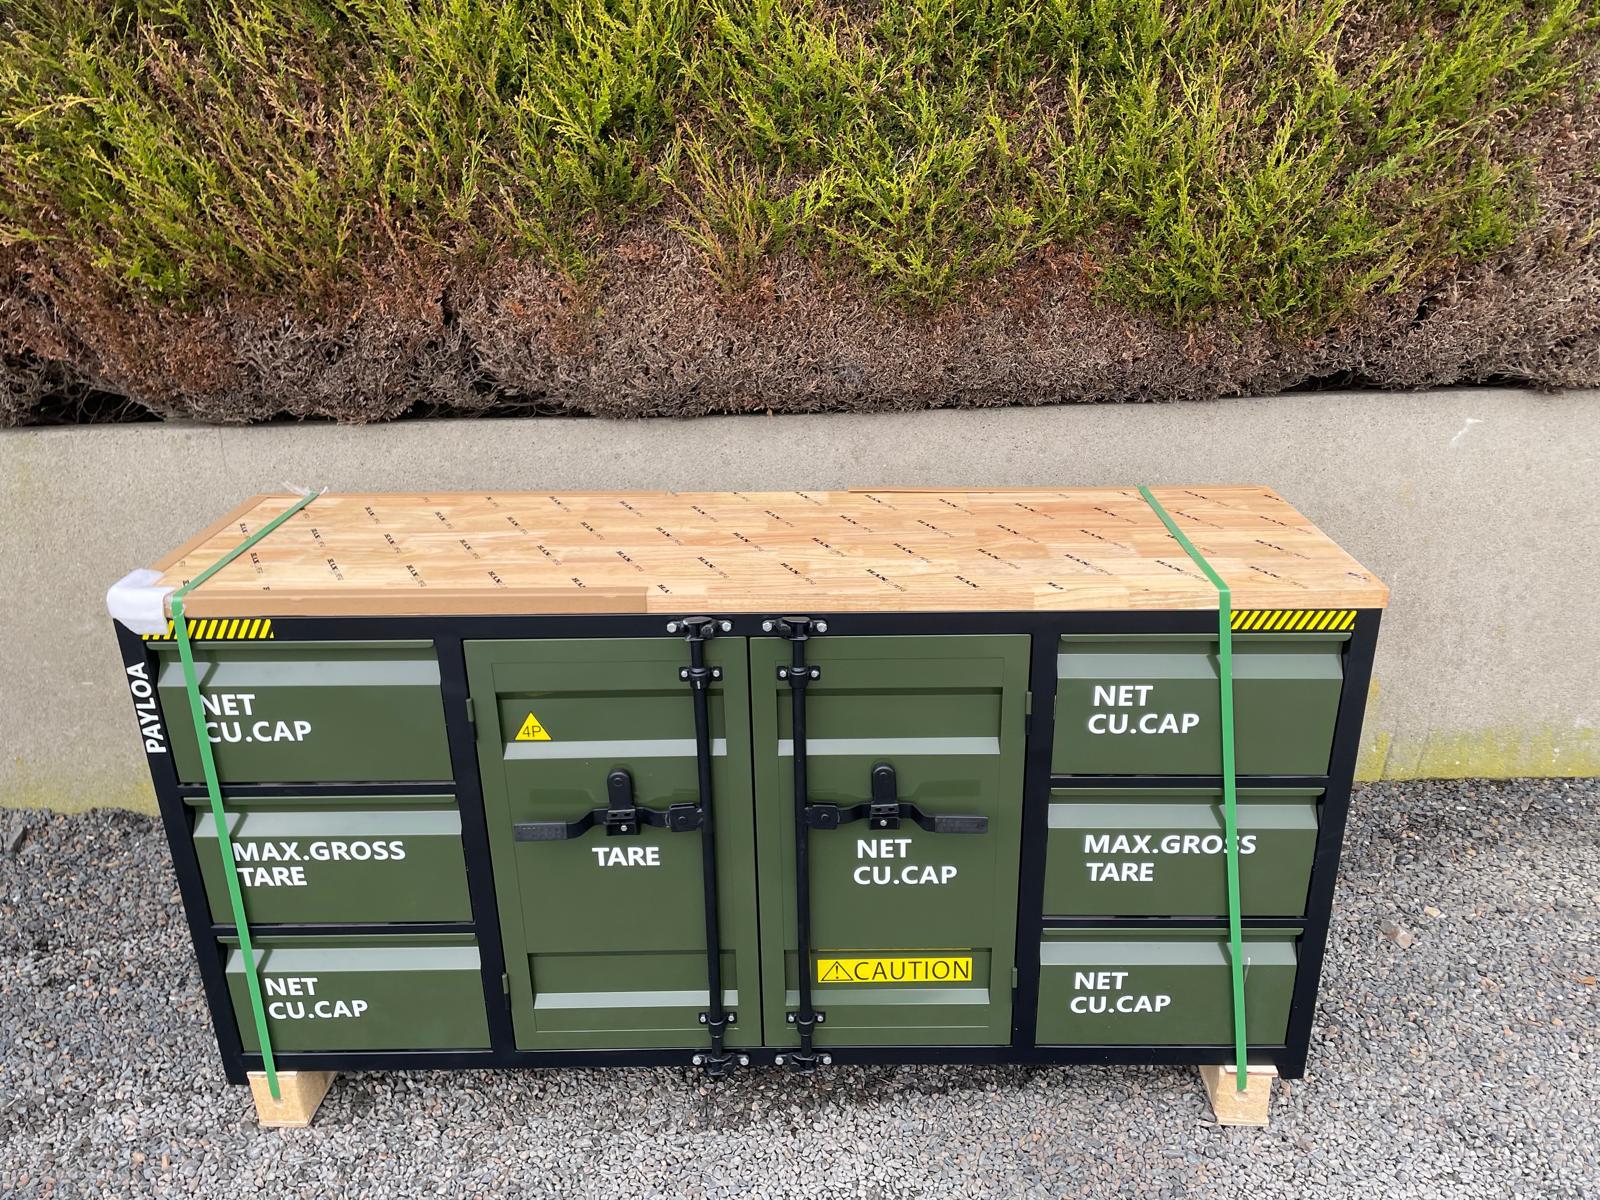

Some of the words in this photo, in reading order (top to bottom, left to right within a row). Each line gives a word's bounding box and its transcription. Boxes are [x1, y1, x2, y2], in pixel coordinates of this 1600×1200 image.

[200, 694, 255, 715] NET
[1094, 685, 1153, 706] NET
[126, 662, 167, 754] PAYLOA
[206, 721, 311, 742] CU.CAP
[521, 724, 542, 738] 4P
[1088, 713, 1199, 734] CU.CAP
[233, 840, 405, 861] MAX.GROSS
[592, 847, 660, 866] TARE
[858, 839, 912, 858] NET
[237, 867, 307, 887] TARE
[854, 866, 957, 884] CU.CAP
[1087, 863, 1154, 881] TARE
[854, 960, 970, 981] CAUTION
[265, 978, 318, 996] NET
[1075, 972, 1128, 989] NET
[269, 1000, 368, 1019] CU.CAP
[1071, 995, 1171, 1013] CU.CAP
